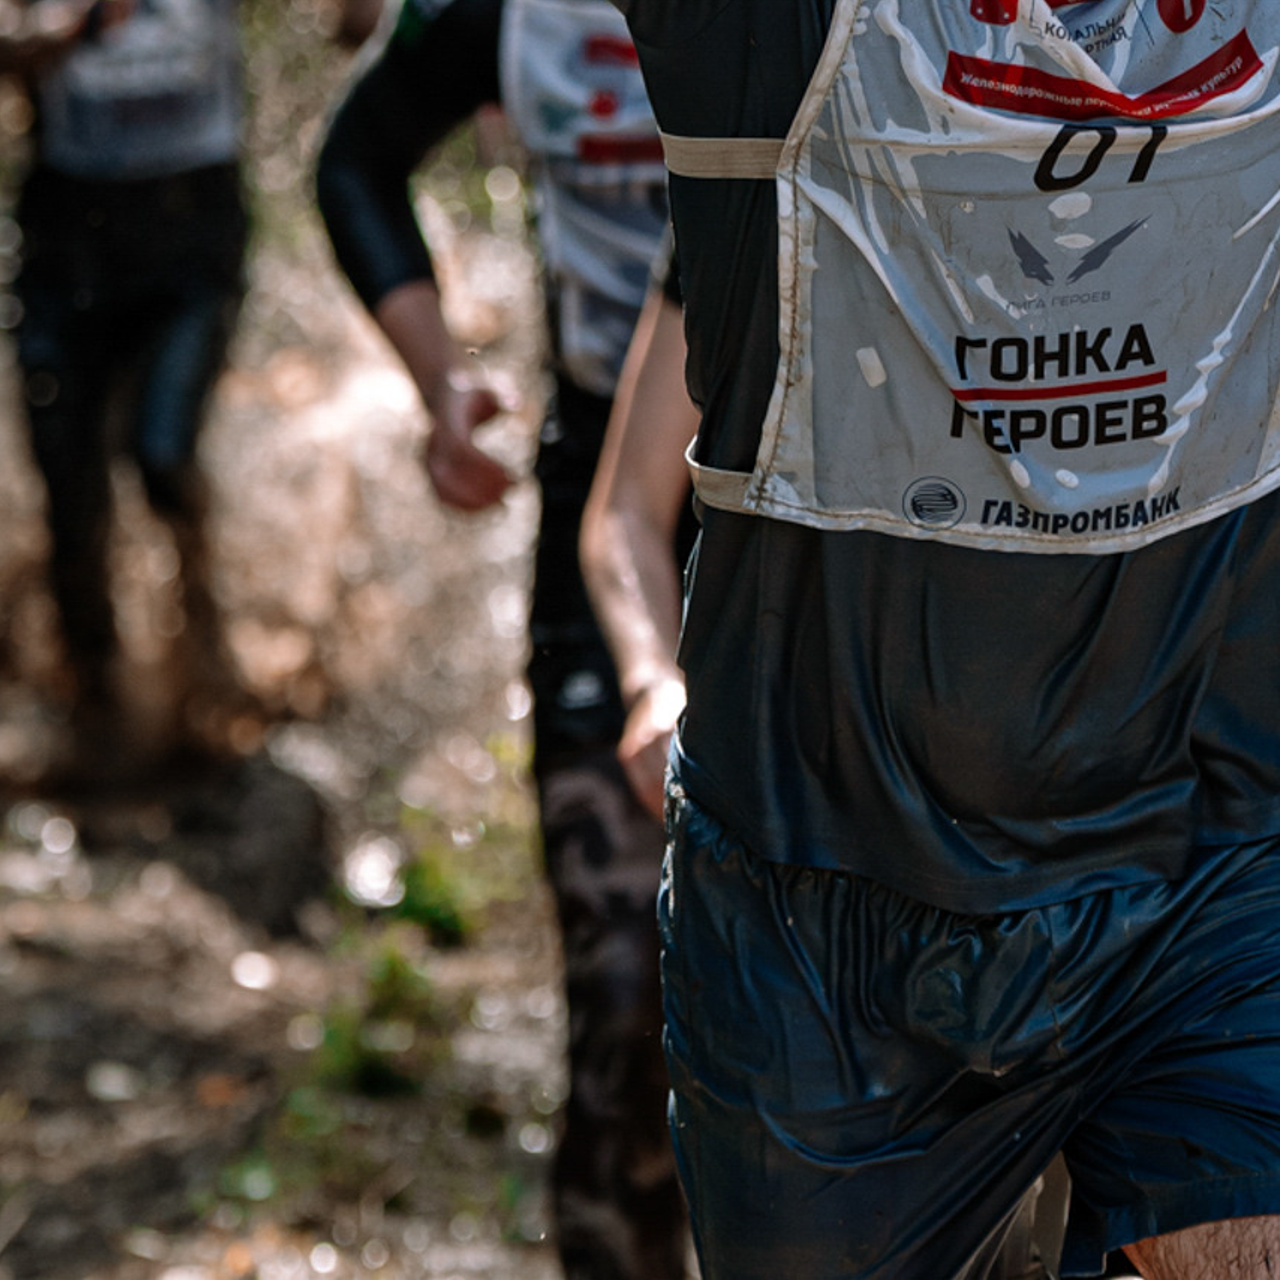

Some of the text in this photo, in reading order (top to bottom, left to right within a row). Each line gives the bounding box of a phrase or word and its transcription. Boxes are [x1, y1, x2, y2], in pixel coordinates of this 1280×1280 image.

[954, 323, 1156, 382] ГОНКА
[950, 393, 1169, 454] ГЕРОЕВ
[980, 485, 1182, 535] ГАЗПРОМБАНК
